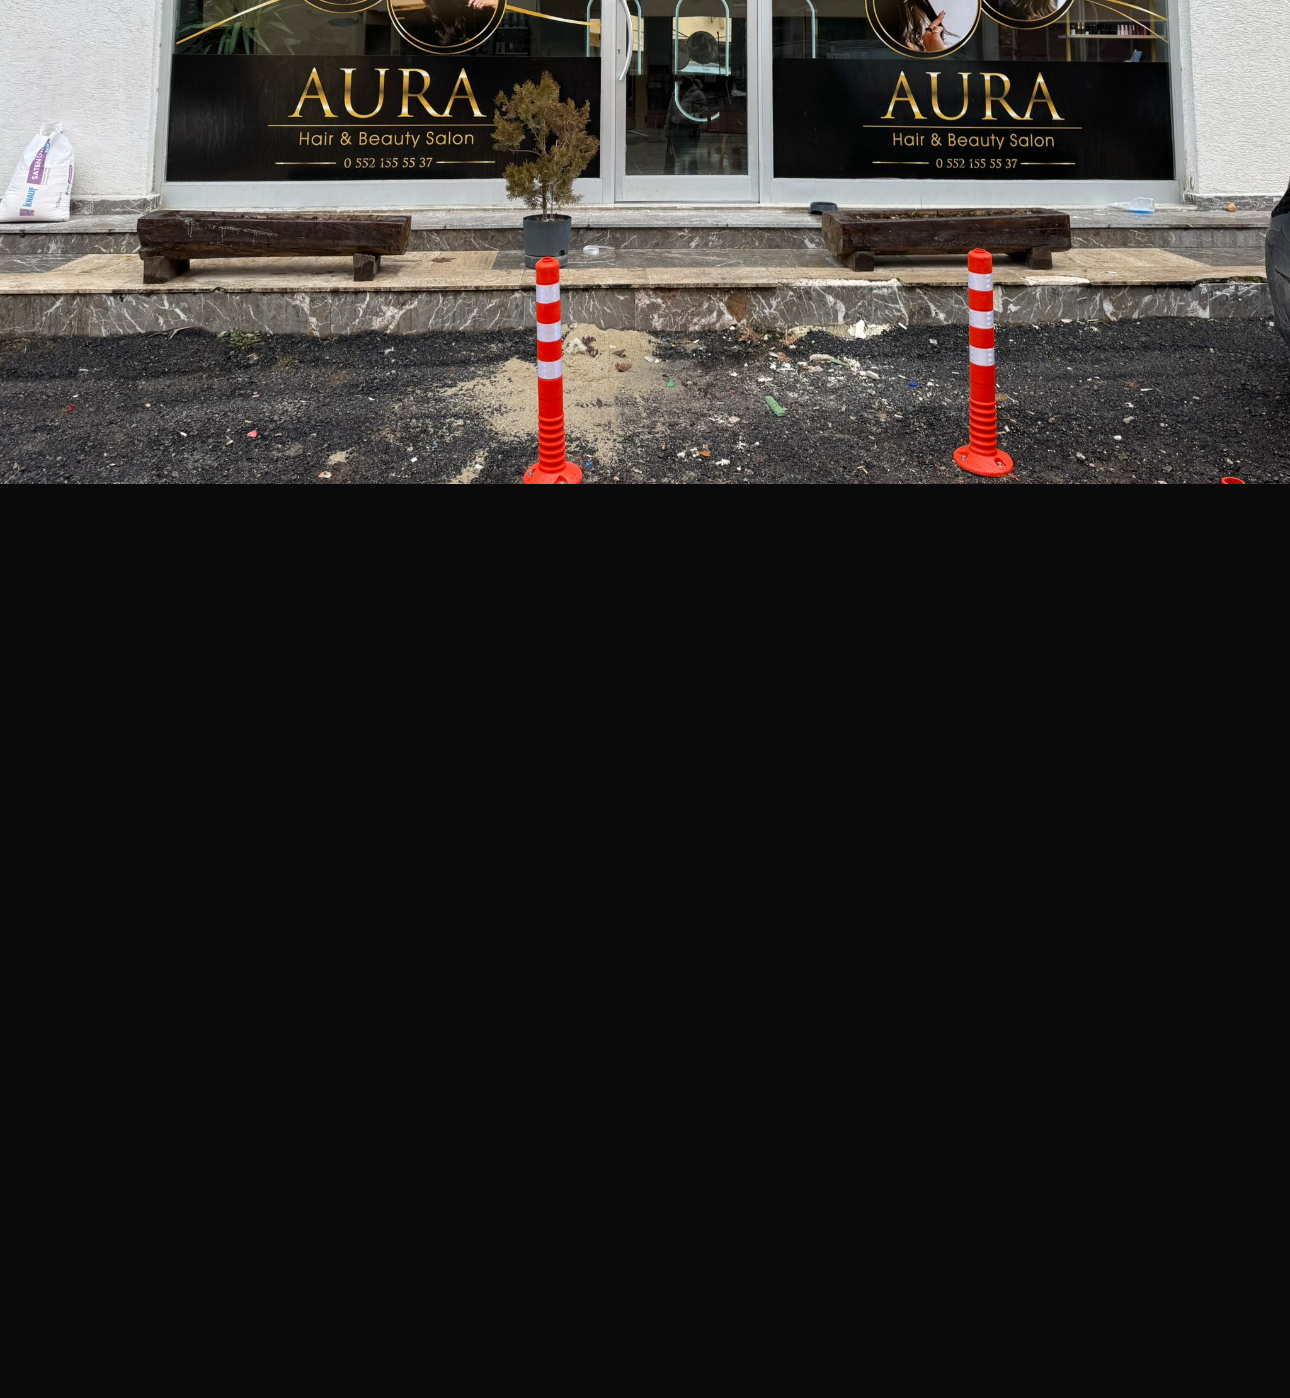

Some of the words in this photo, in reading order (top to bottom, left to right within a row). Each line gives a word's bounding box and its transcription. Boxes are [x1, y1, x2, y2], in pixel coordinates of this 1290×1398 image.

[287, 66, 487, 119] AURA
[880, 70, 1065, 121] AURA
[299, 131, 334, 146] Hair
[339, 131, 352, 146] &
[358, 131, 421, 148] Beauty
[425, 130, 475, 146] Salon
[892, 132, 925, 147] Hair
[930, 132, 942, 147] &
[948, 132, 1005, 150] Beauty
[1009, 133, 1055, 148] Salon
[343, 157, 352, 169] 0
[355, 157, 376, 169] 552
[380, 157, 399, 169] 155
[402, 157, 416, 169] 55
[419, 157, 433, 169] 37
[935, 158, 943, 169] 0
[946, 158, 965, 169] 552
[969, 158, 987, 169] 155
[989, 158, 1002, 169] 55
[1005, 158, 1018, 169] 37
